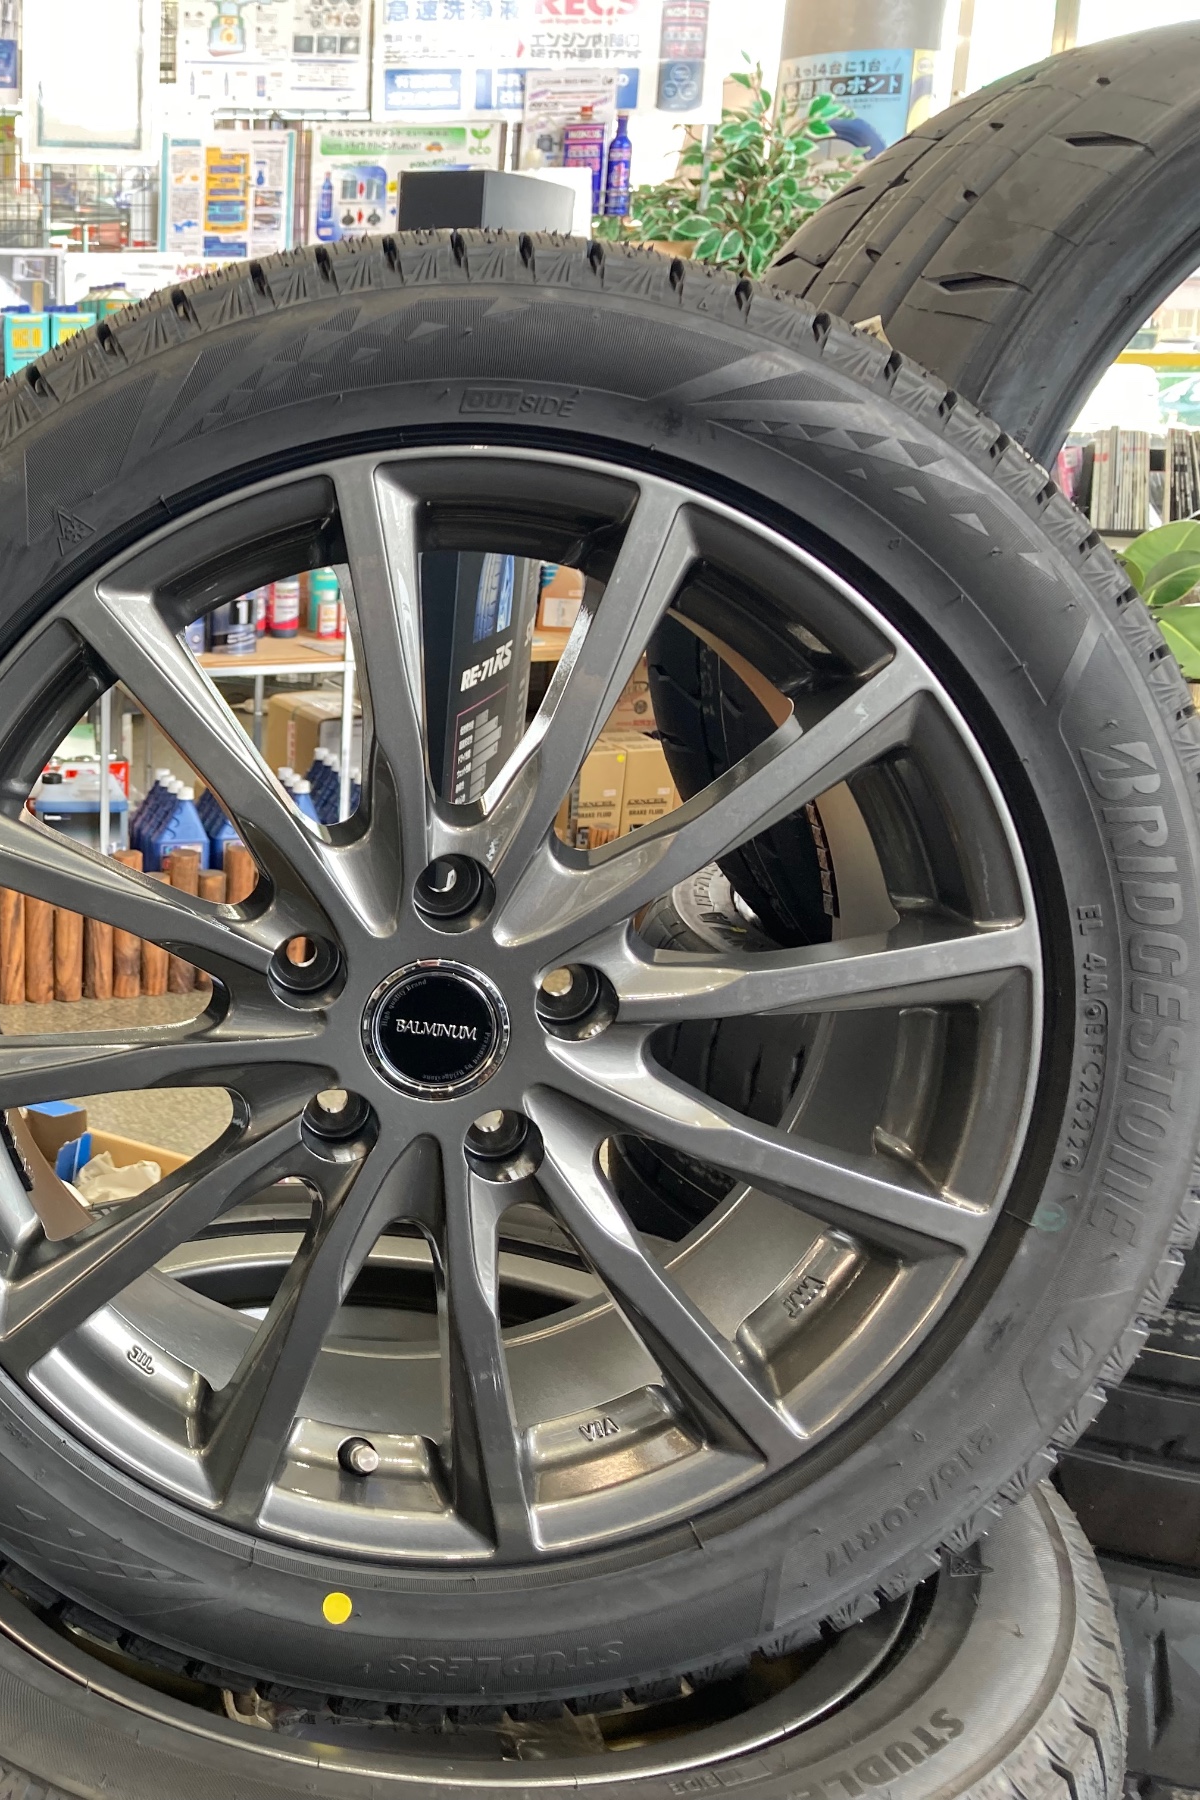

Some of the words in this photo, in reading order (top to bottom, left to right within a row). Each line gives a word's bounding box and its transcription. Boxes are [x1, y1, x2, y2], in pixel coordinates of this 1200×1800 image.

[460, 640, 513, 692] RE-71RS
[1076, 904, 1103, 936] EL
[1079, 741, 1190, 1248] BRIDGESTONE
[395, 1018, 477, 1040] BALMINUM
[578, 1416, 620, 1442] VIA
[824, 1423, 999, 1577] 215/50R17
[387, 1640, 625, 1681] STUDLESS
